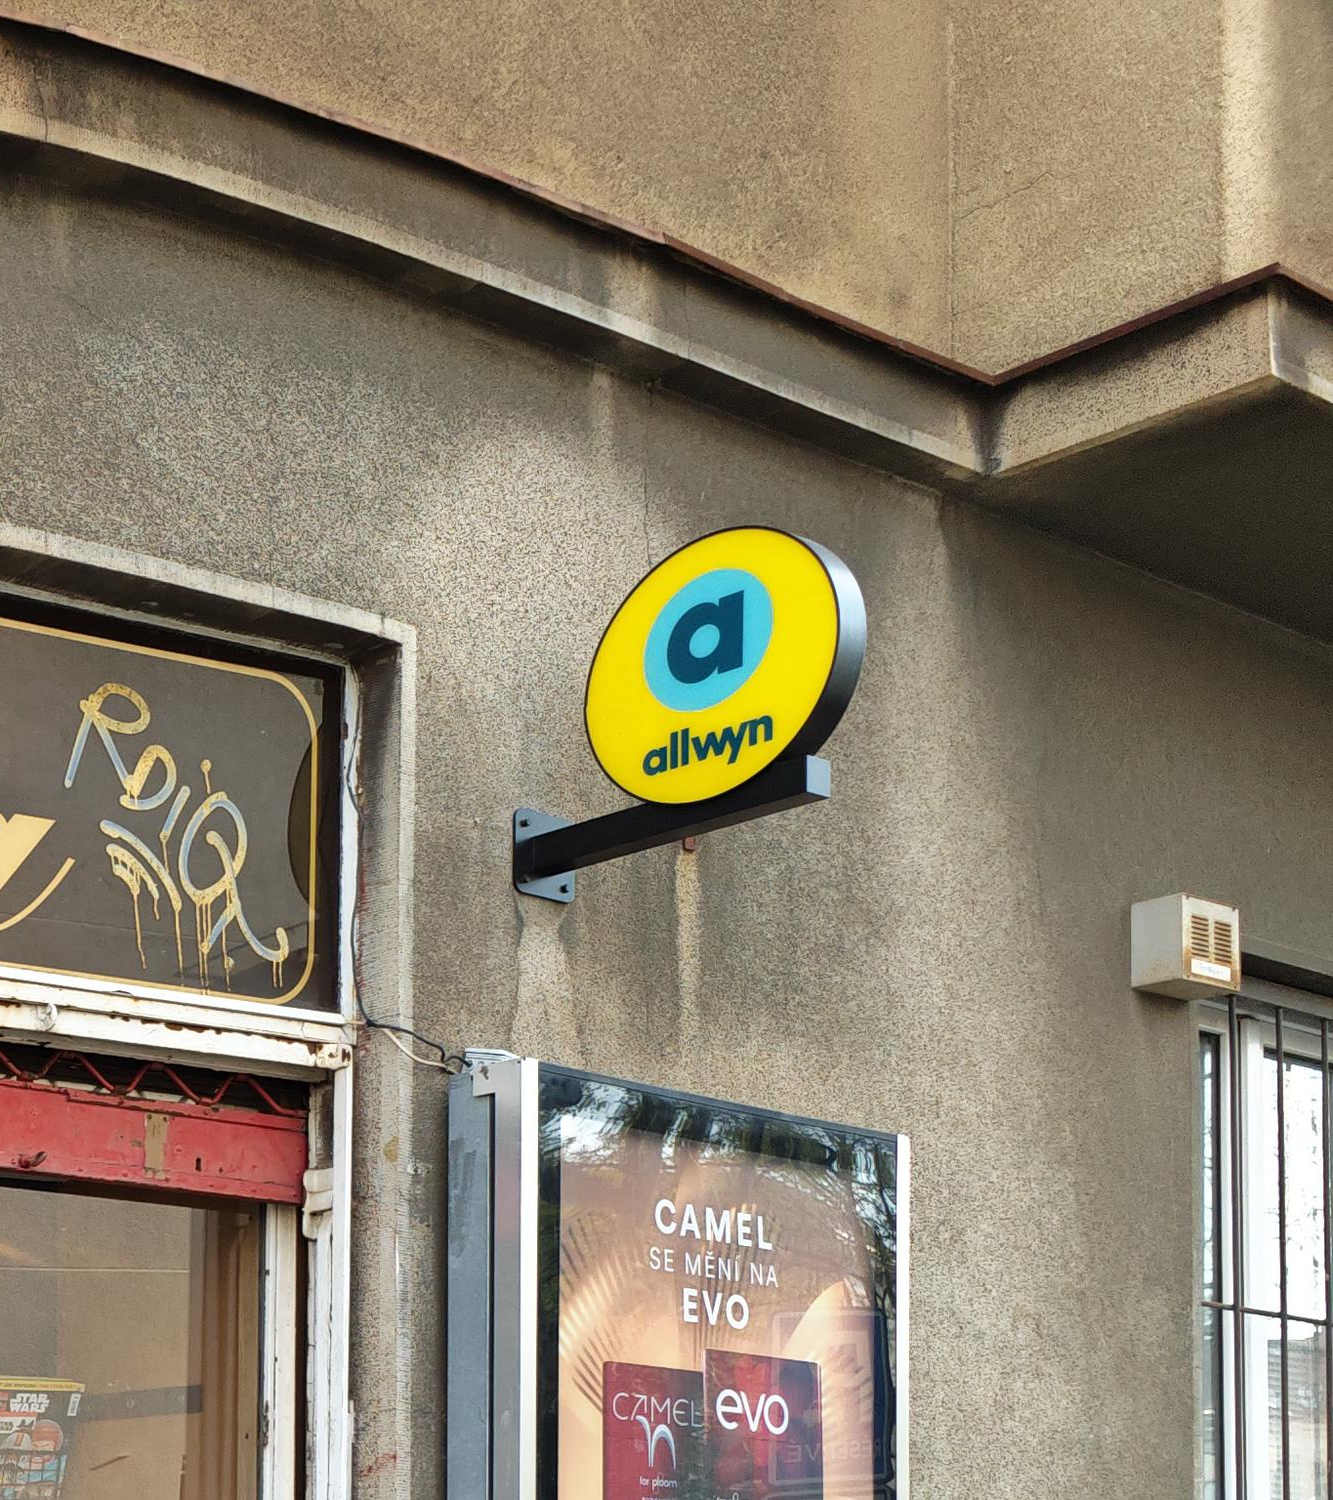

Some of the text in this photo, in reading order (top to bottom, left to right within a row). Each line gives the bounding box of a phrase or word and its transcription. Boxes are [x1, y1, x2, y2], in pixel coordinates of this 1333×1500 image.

[667, 589, 744, 684] a
[643, 715, 773, 776] allwyn
[654, 1198, 774, 1251] CAMEL
[649, 1246, 779, 1289] SE MĚNÍ NA
[683, 1288, 749, 1329] EVO
[9, 1399, 50, 1413] WARS
[14, 1393, 49, 1403] STAR
[613, 1392, 704, 1428] CAMEL
[716, 1389, 789, 1435] evo
